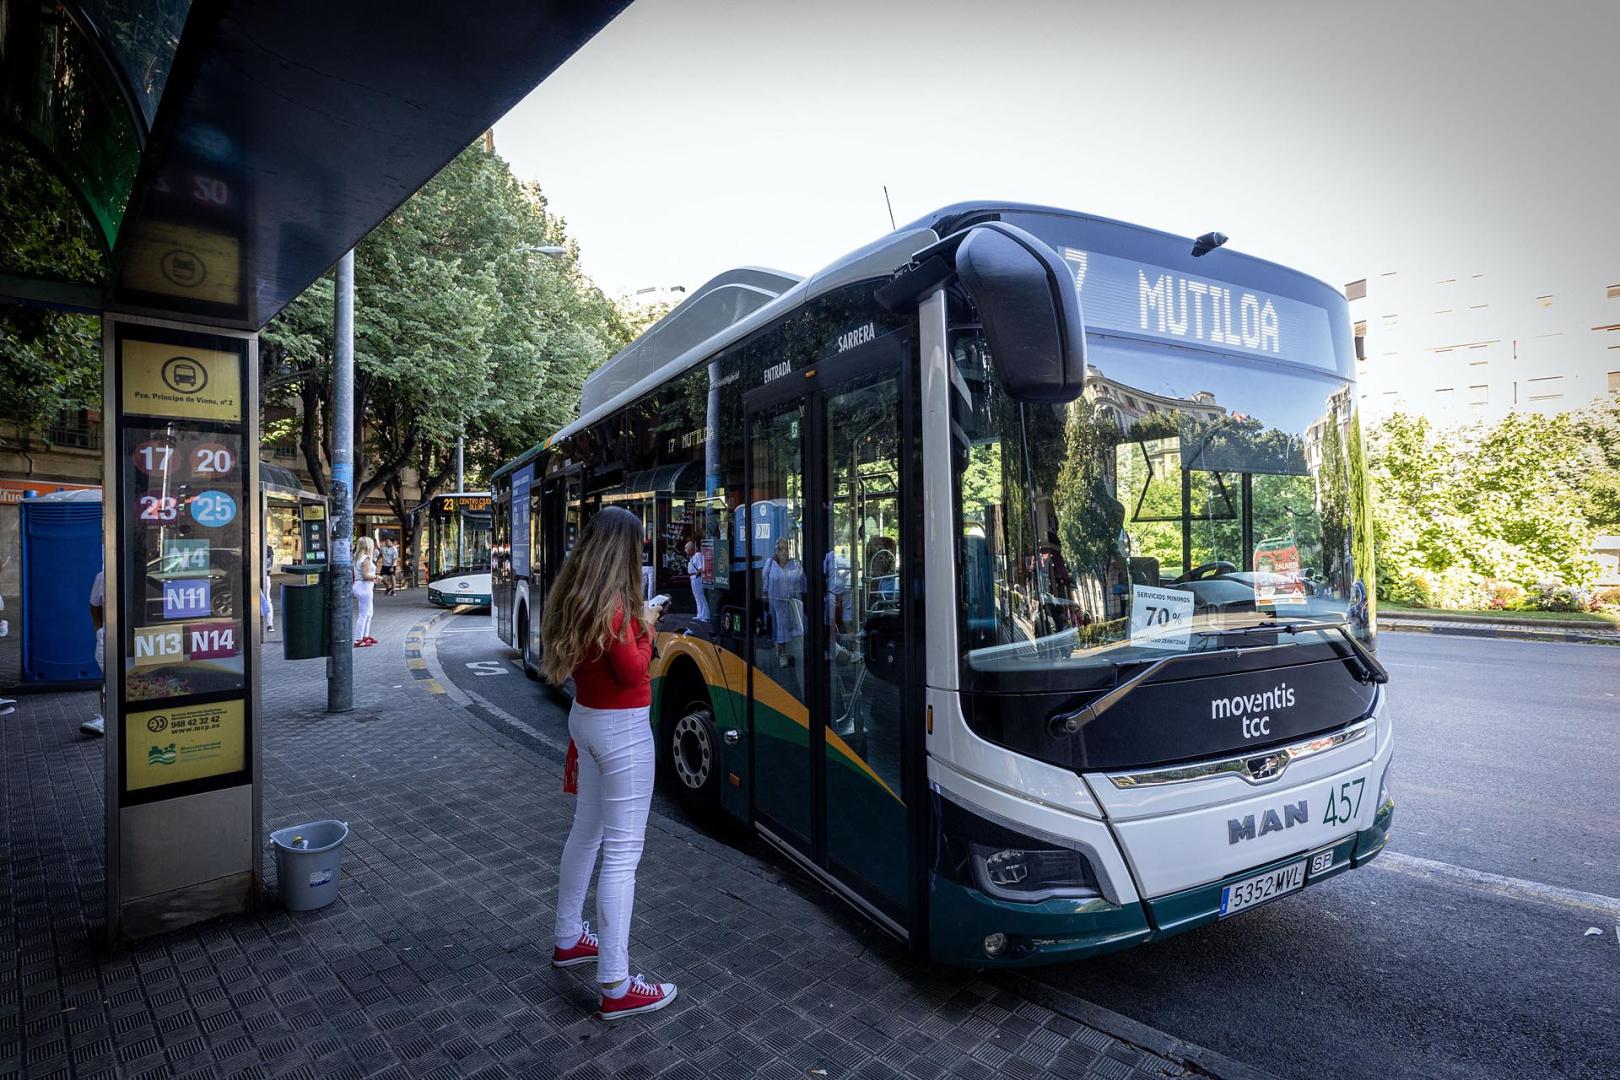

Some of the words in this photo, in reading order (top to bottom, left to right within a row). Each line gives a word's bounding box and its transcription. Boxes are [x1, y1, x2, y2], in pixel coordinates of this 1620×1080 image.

[1138, 269, 1280, 353] MUTILOA
[838, 322, 876, 353] SARRERA
[763, 360, 792, 384] ENTRADA
[140, 446, 175, 471] 17
[196, 449, 232, 473] 20
[140, 495, 177, 520] 23
[198, 497, 232, 521] 25
[443, 498, 454, 511] 23
[168, 547, 206, 568] N4
[167, 587, 206, 610] N11
[1137, 591, 1166, 601] SERVICIOS
[1167, 595, 1191, 604] MINIMOS
[1146, 606, 1170, 628] 70
[134, 632, 181, 658] N13
[191, 629, 235, 653] N14
[1211, 682, 1296, 720] moventis
[171, 719, 186, 729] 948
[188, 718, 198, 726] 42
[199, 717, 209, 725] 32
[211, 715, 220, 723] 42
[1242, 714, 1270, 739] tcc
[1322, 777, 1366, 827] 457
[1227, 800, 1309, 846] MAN
[1313, 853, 1333, 871] SP
[1234, 876, 1275, 908] 5352
[1275, 866, 1301, 893] MVL
